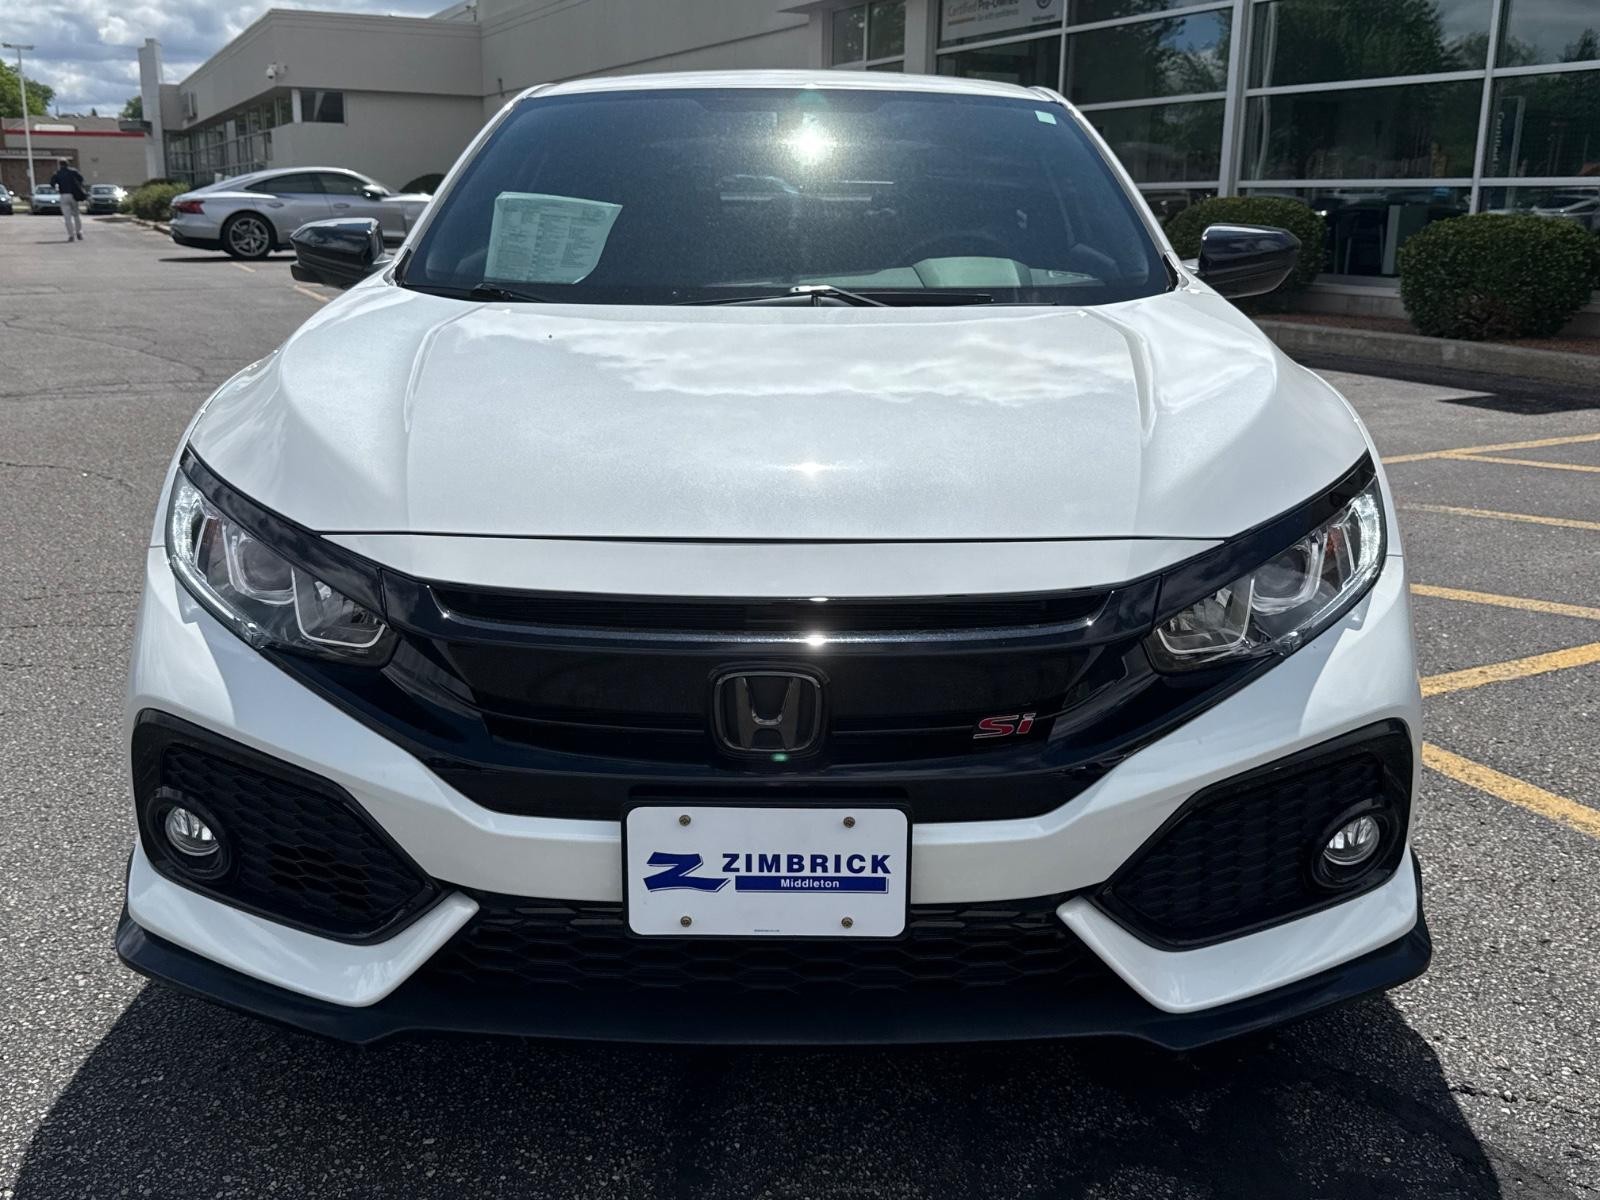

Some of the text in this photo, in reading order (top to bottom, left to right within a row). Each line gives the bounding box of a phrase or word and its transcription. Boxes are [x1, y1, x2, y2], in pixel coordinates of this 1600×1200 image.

[973, 712, 1037, 739] Si
[721, 852, 892, 874] ZIMBRICK
[780, 878, 840, 889] Middleton
